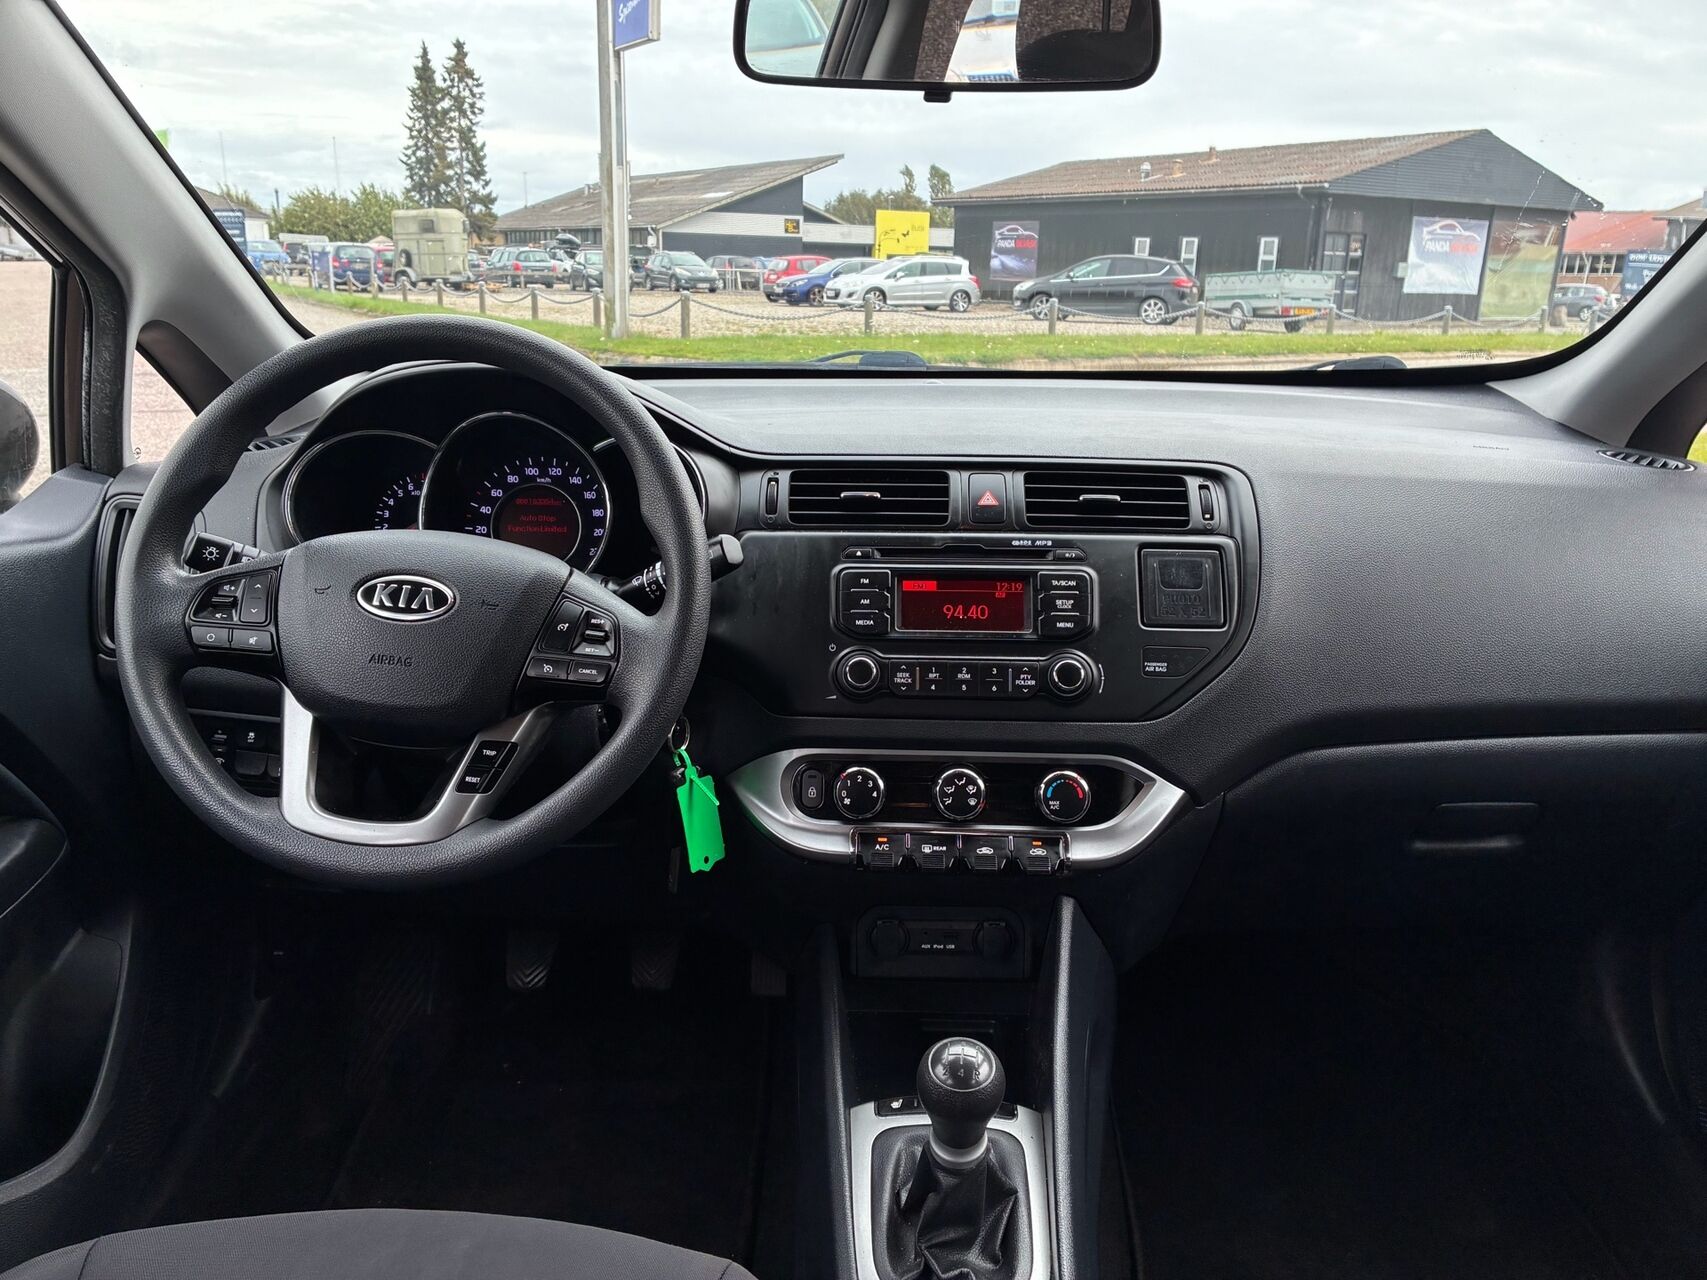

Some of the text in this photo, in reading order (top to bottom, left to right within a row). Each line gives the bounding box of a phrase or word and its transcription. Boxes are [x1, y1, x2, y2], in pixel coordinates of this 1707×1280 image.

[507, 475, 519, 483] 80
[569, 476, 582, 484] 140
[584, 491, 596, 499] 160
[480, 506, 491, 514] 40
[592, 509, 604, 517] 180
[476, 526, 487, 534] 20
[996, 582, 1022, 591] 12:19
[372, 583, 434, 610] KIA
[943, 605, 989, 619] 94.40
[368, 653, 413, 667] AIRBAG
[958, 1069, 964, 1077] 4
[973, 1069, 980, 1080] R
